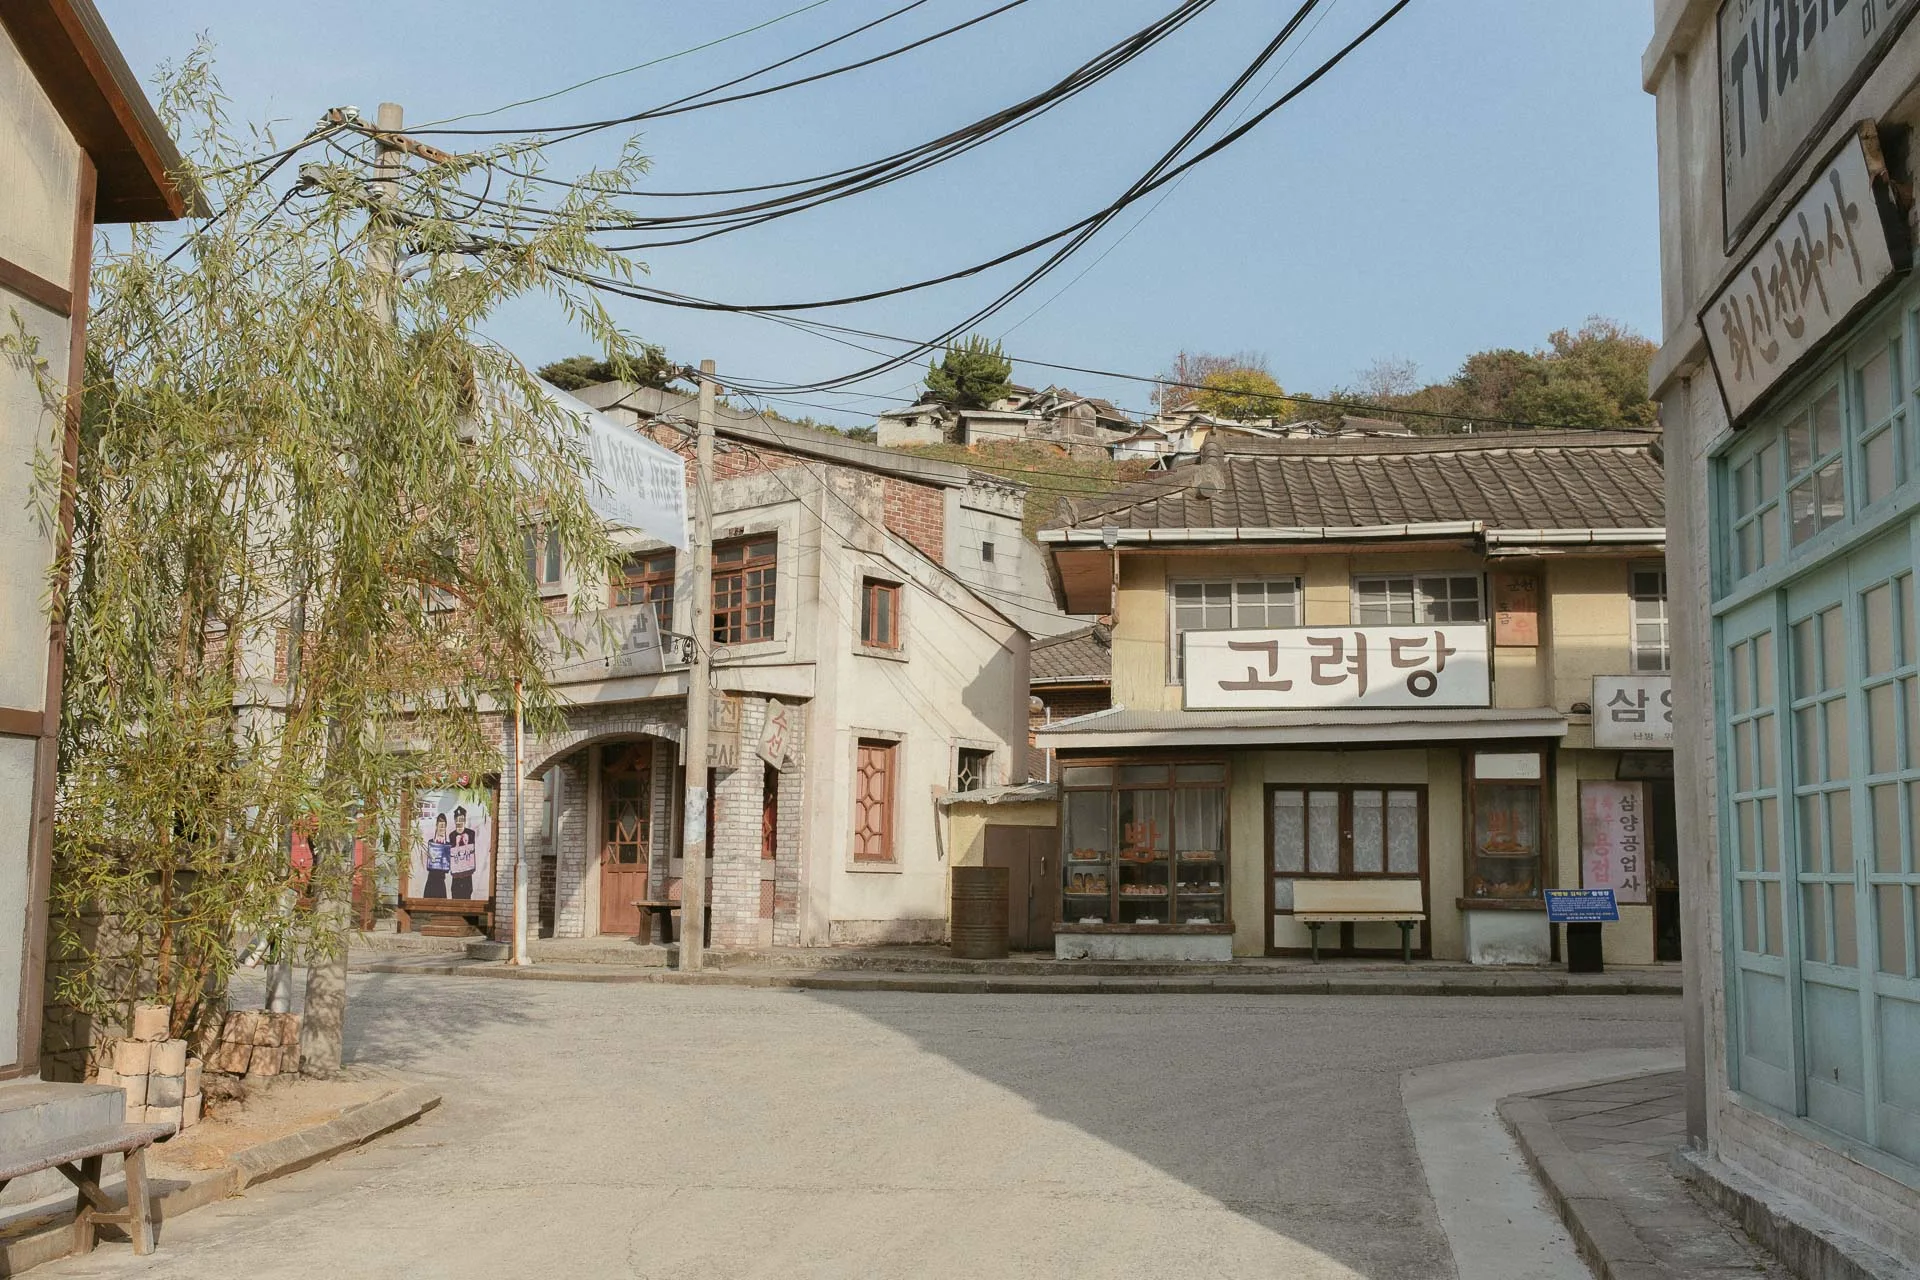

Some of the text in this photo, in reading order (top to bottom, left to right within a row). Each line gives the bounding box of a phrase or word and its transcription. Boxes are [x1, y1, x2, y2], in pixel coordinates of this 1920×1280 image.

[1218, 630, 1456, 698] 고려당
[766, 710, 788, 759] 수선
[1125, 818, 1161, 864] 빵
[1618, 794, 1641, 893] 삼양공업사
